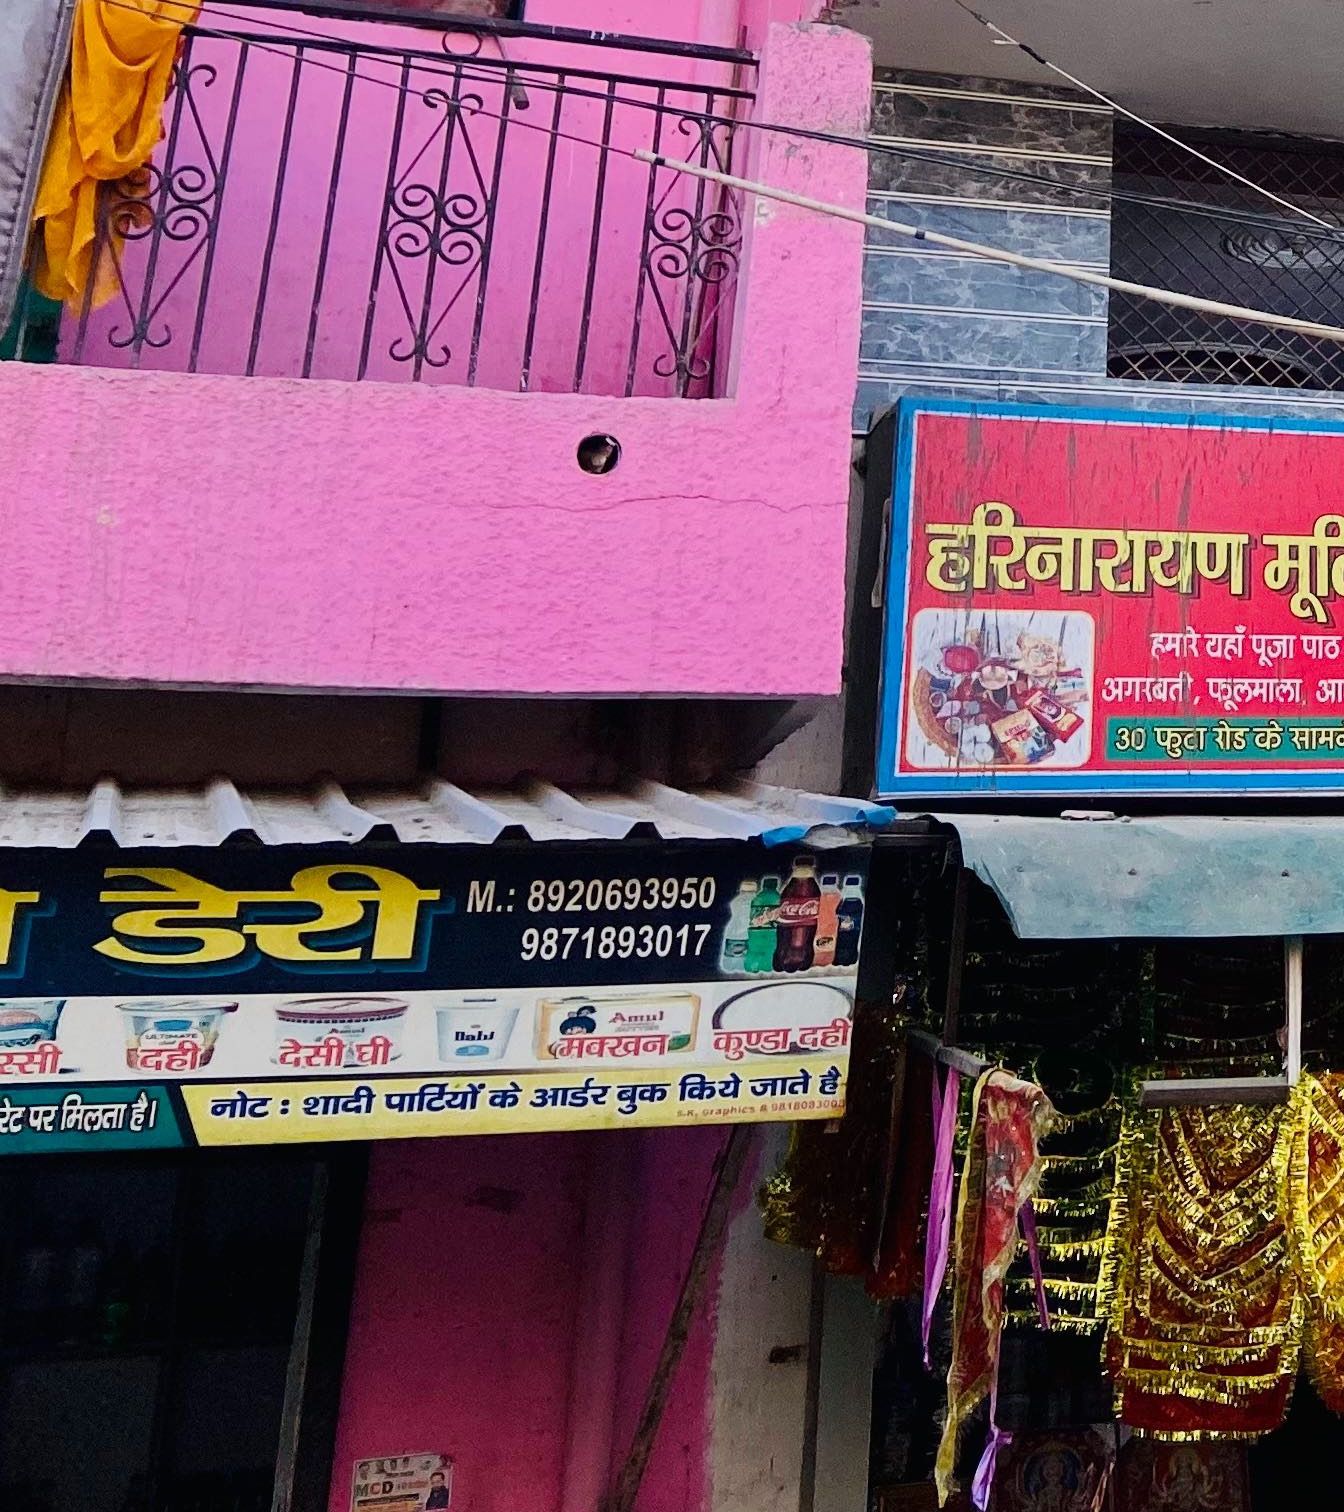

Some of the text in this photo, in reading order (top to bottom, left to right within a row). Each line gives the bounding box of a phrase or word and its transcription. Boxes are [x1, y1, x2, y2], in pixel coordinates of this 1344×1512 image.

[924, 501, 1249, 596] हरिनारायण
[1150, 626, 1200, 661] हमारे
[1205, 624, 1248, 662] यहाँ
[1250, 634, 1297, 667] पूजा
[1301, 635, 1342, 661] पाठ
[1115, 726, 1148, 751] 30
[1212, 719, 1250, 751] रोड
[1253, 719, 1284, 751] के
[527, 876, 716, 912] 8920693950
[92, 864, 441, 965] डेरी
[520, 924, 712, 961] 9871893017
[608, 1009, 665, 1024] Amul
[799, 1018, 853, 1049] दही
[139, 1039, 201, 1072] दही
[279, 1035, 393, 1068] देसी घी
[210, 1090, 274, 1119] नोट
[302, 1084, 377, 1116] शादी
[385, 1077, 486, 1113] पार्टियों
[488, 1081, 520, 1110] के
[529, 1078, 612, 1109] आर्डर
[617, 1083, 672, 1115] बुक
[679, 1071, 744, 1102] किये
[749, 1068, 813, 1098] जाते
[28, 1104, 57, 1133] पर
[59, 1094, 128, 1134] मिलता
